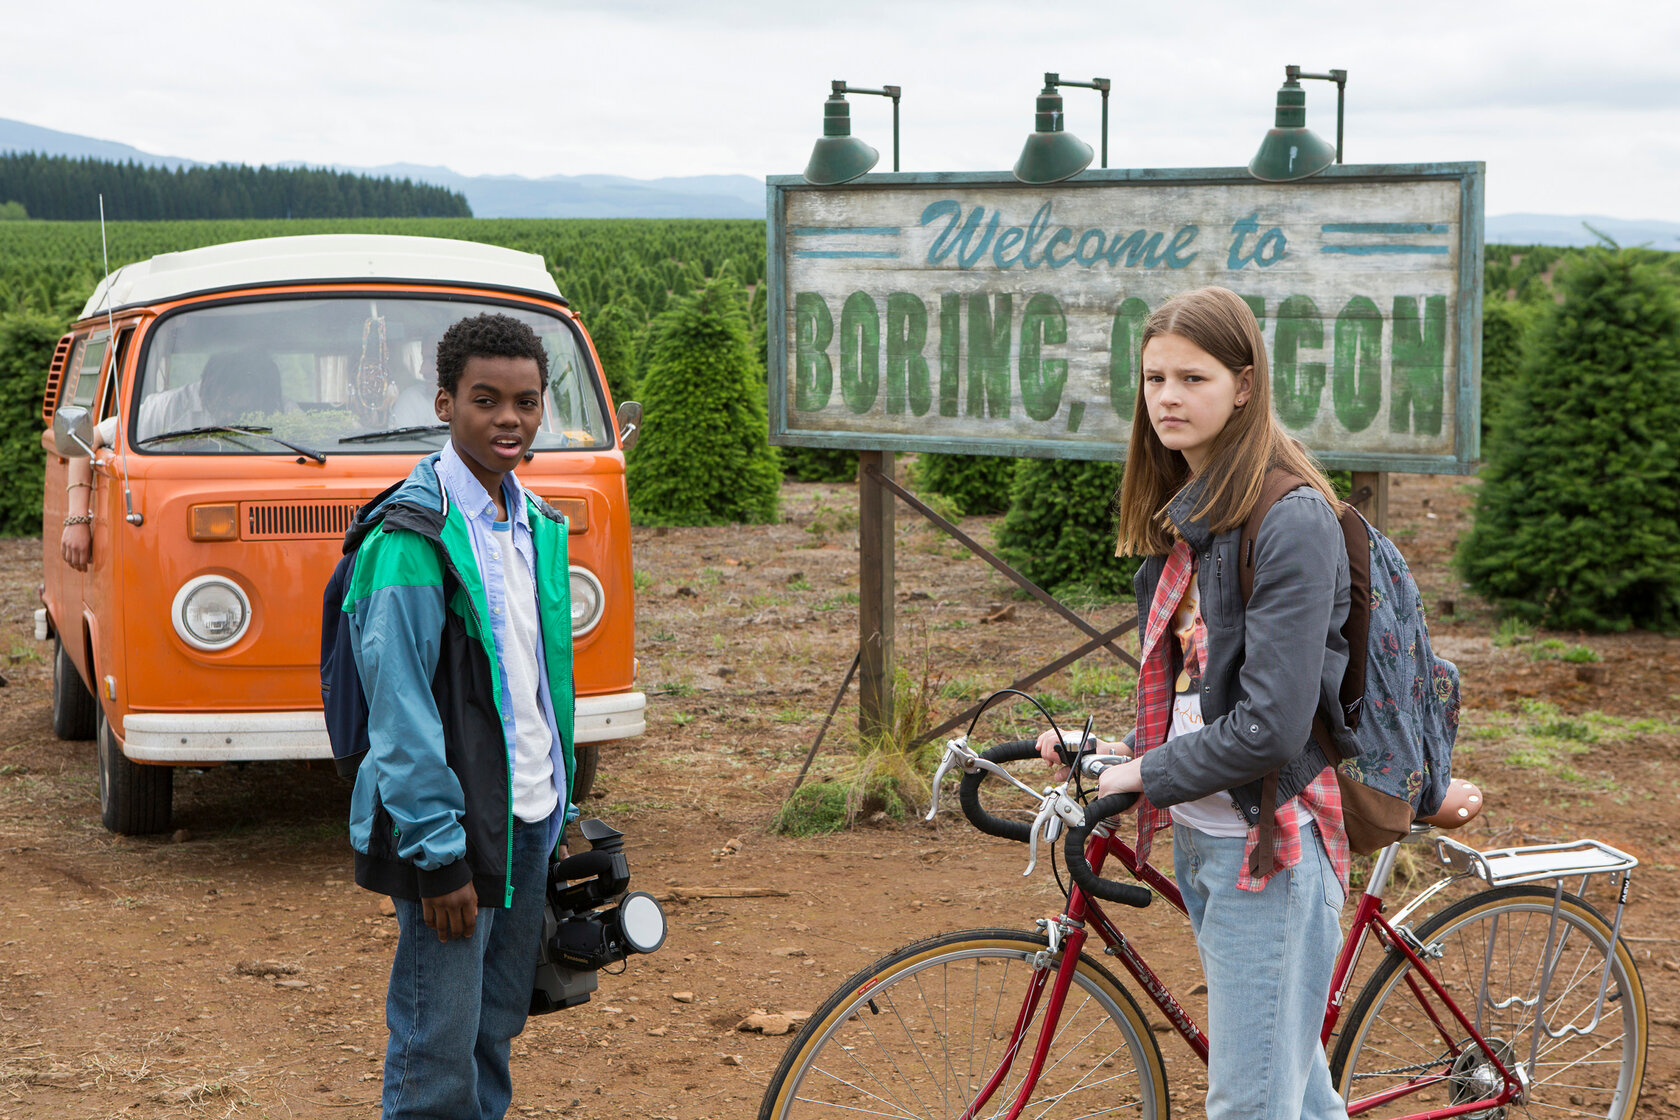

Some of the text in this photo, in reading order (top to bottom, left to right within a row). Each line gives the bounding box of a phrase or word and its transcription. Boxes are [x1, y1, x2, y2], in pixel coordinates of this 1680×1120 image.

[921, 199, 1289, 270] Welcome to
[795, 289, 1447, 437] BORING, OGON
